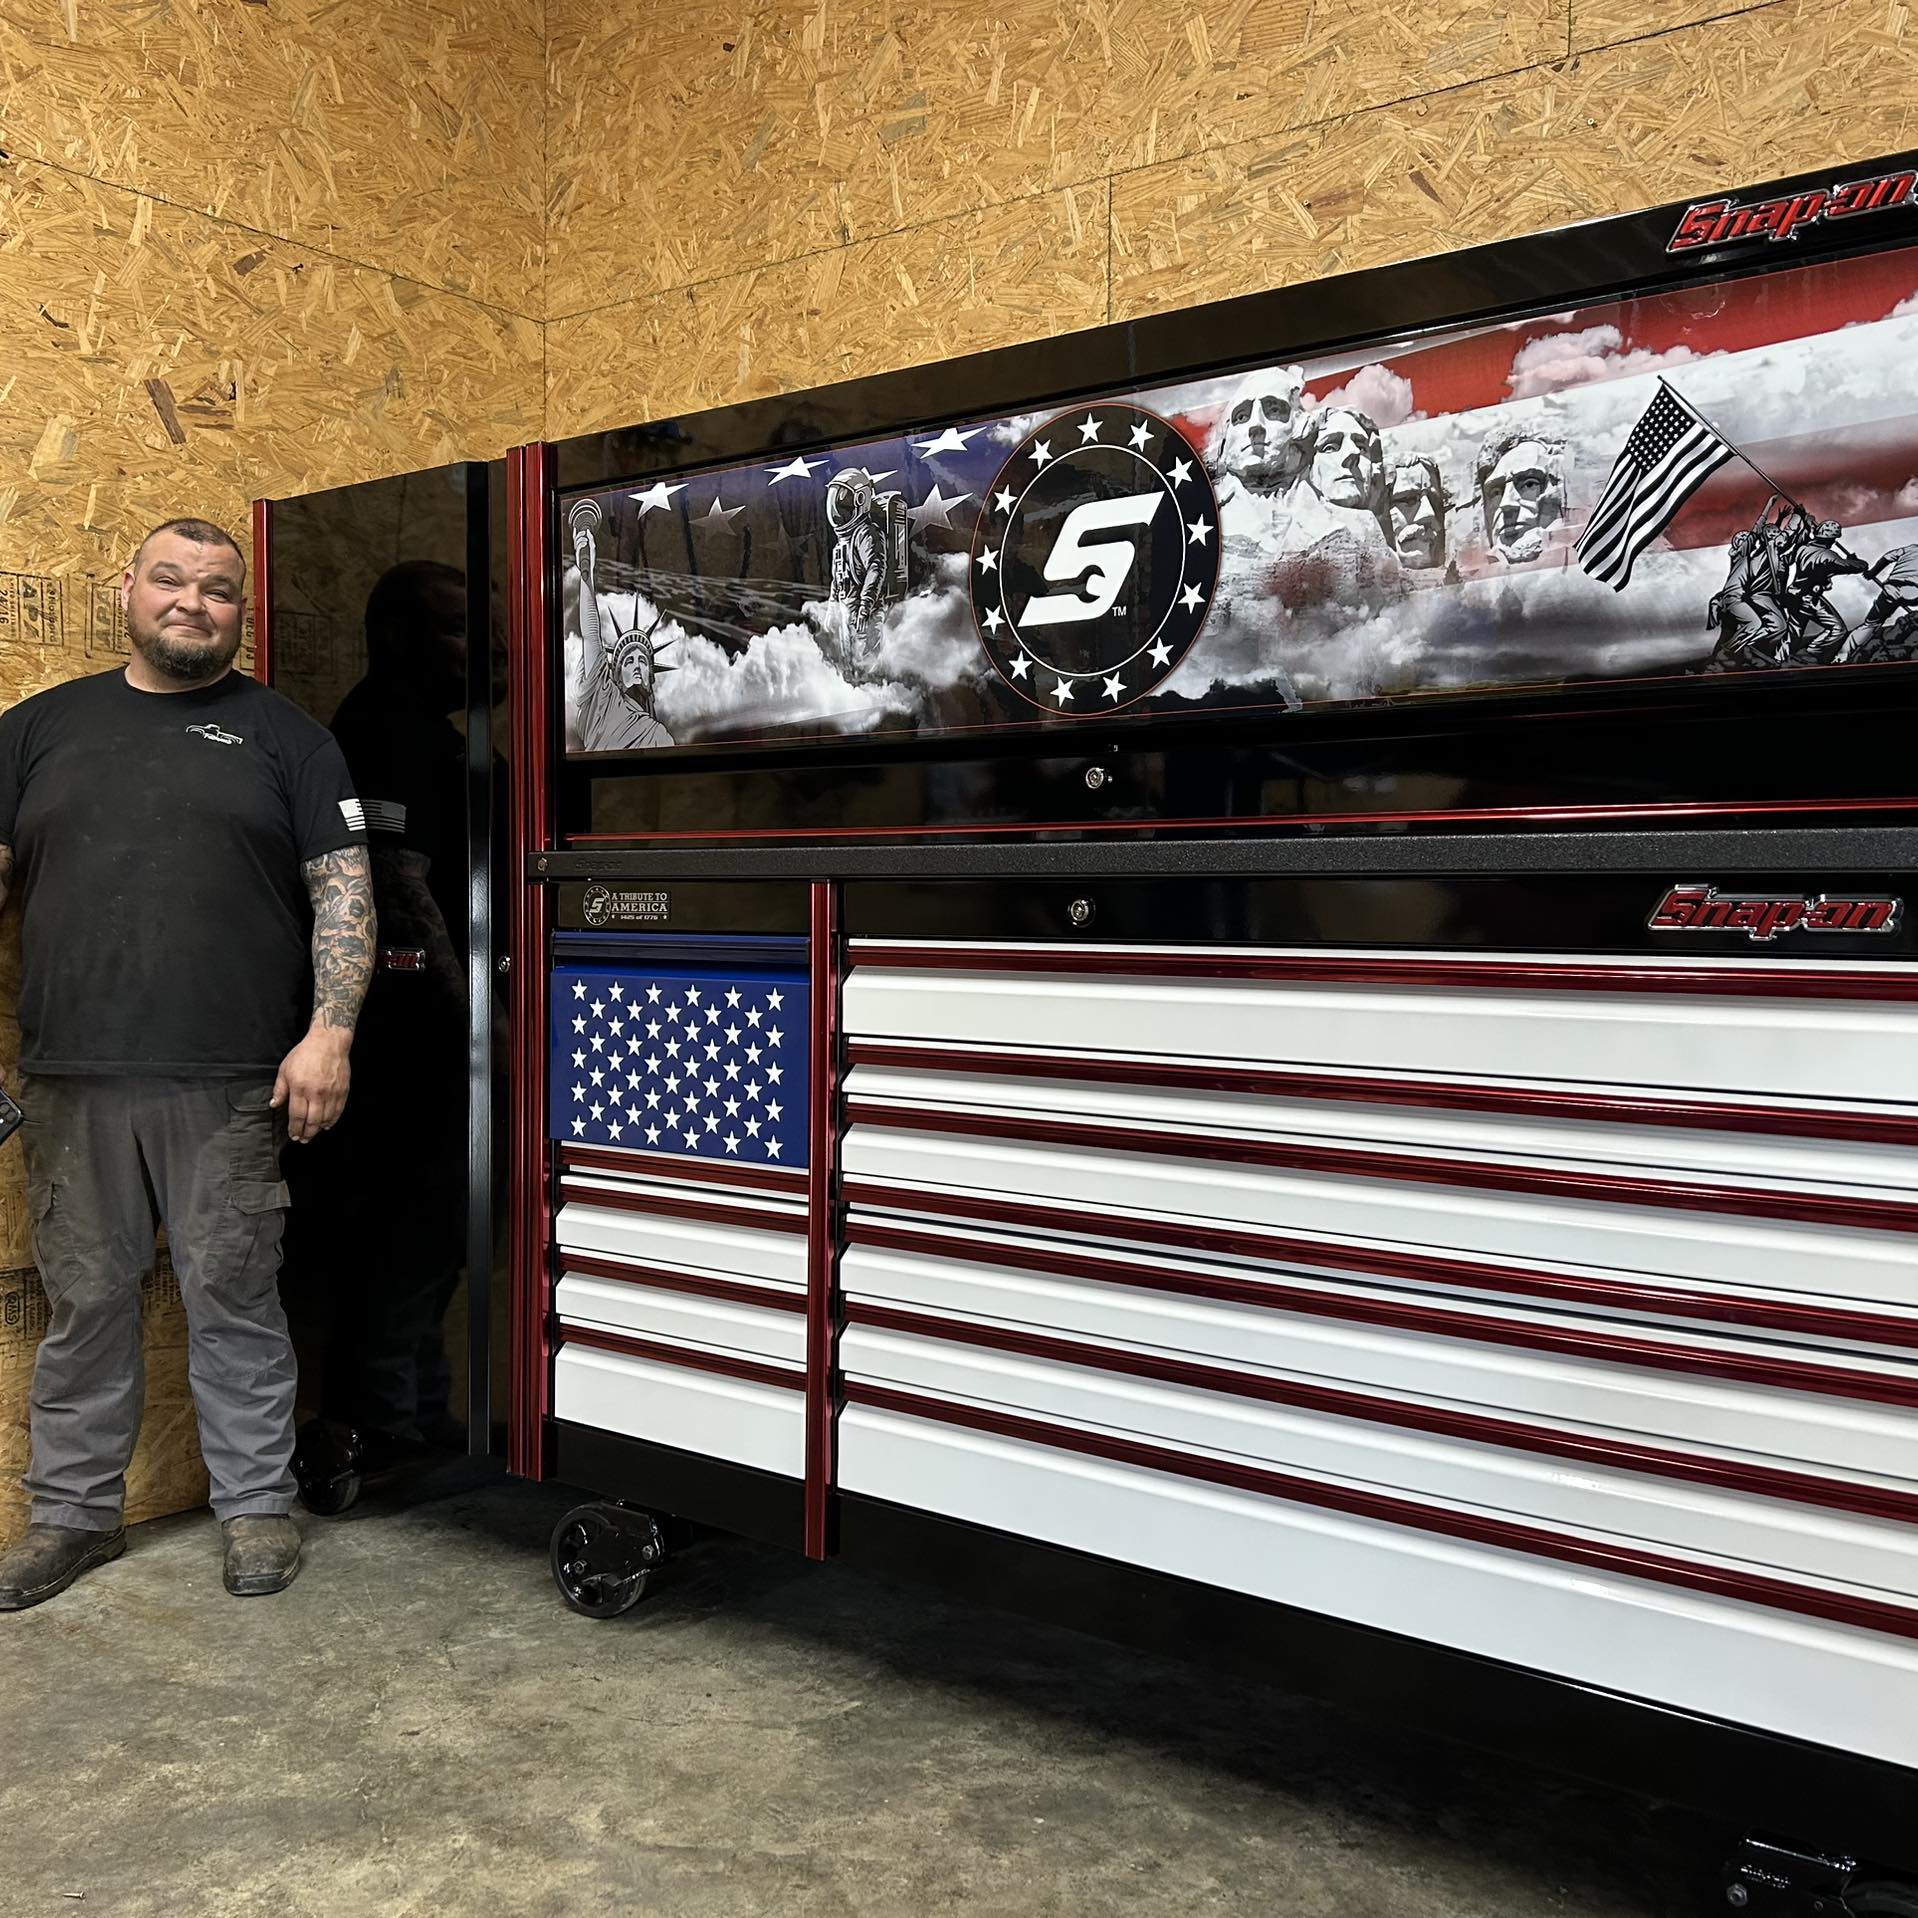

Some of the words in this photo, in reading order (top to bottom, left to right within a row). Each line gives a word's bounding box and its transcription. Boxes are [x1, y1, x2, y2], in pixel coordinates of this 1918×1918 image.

[1667, 173, 1916, 252] Snap-on
[1111, 605, 1127, 618] TM
[611, 892, 618, 901] A
[619, 892, 654, 901] TRIBUTE
[654, 892, 668, 901] TO
[611, 902, 668, 912] AMERICA
[1648, 884, 1902, 940] Snap-on
